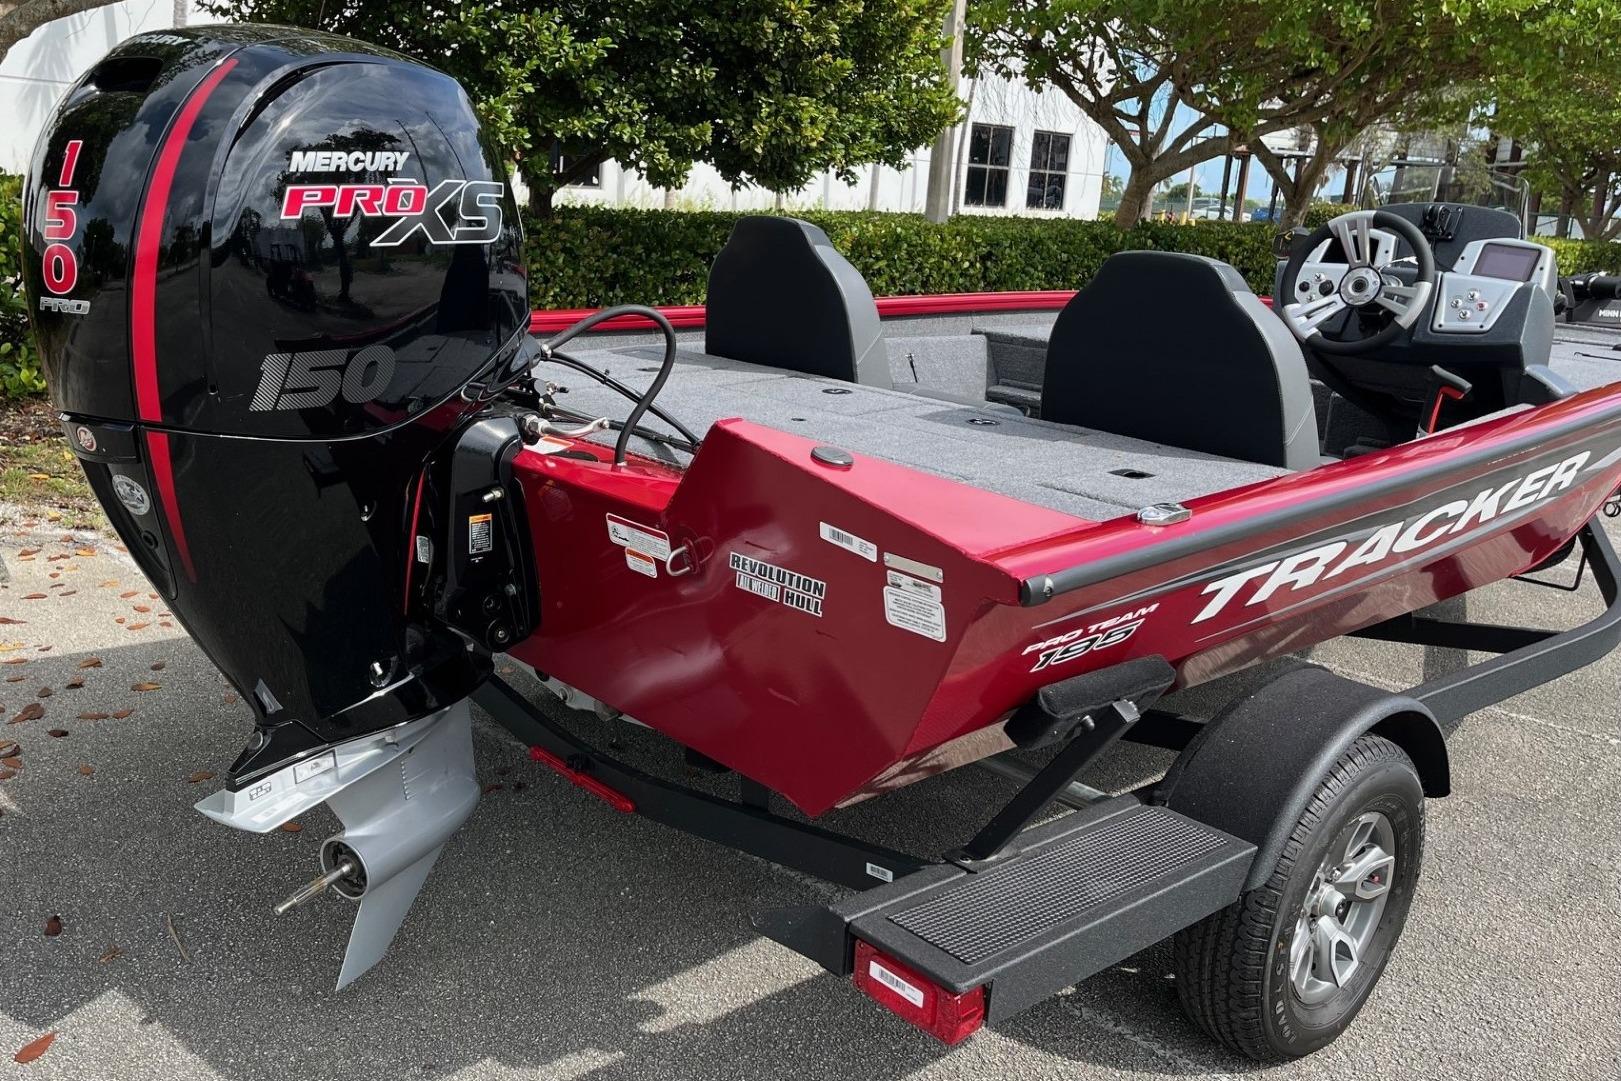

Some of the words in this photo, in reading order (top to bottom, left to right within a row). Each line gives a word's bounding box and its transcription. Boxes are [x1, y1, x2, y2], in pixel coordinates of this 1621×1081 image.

[289, 151, 410, 172] MERCURY
[43, 140, 83, 295] 150
[280, 185, 428, 219] PRO
[370, 178, 504, 247] XS
[249, 344, 396, 412] 150
[1190, 450, 1591, 625] TRACKER
[731, 553, 825, 598] REVOLUTION
[784, 590, 822, 615] HULL
[1021, 629, 1083, 655] PRO
[1087, 603, 1160, 634] TEAM
[1029, 618, 1146, 673] 195
